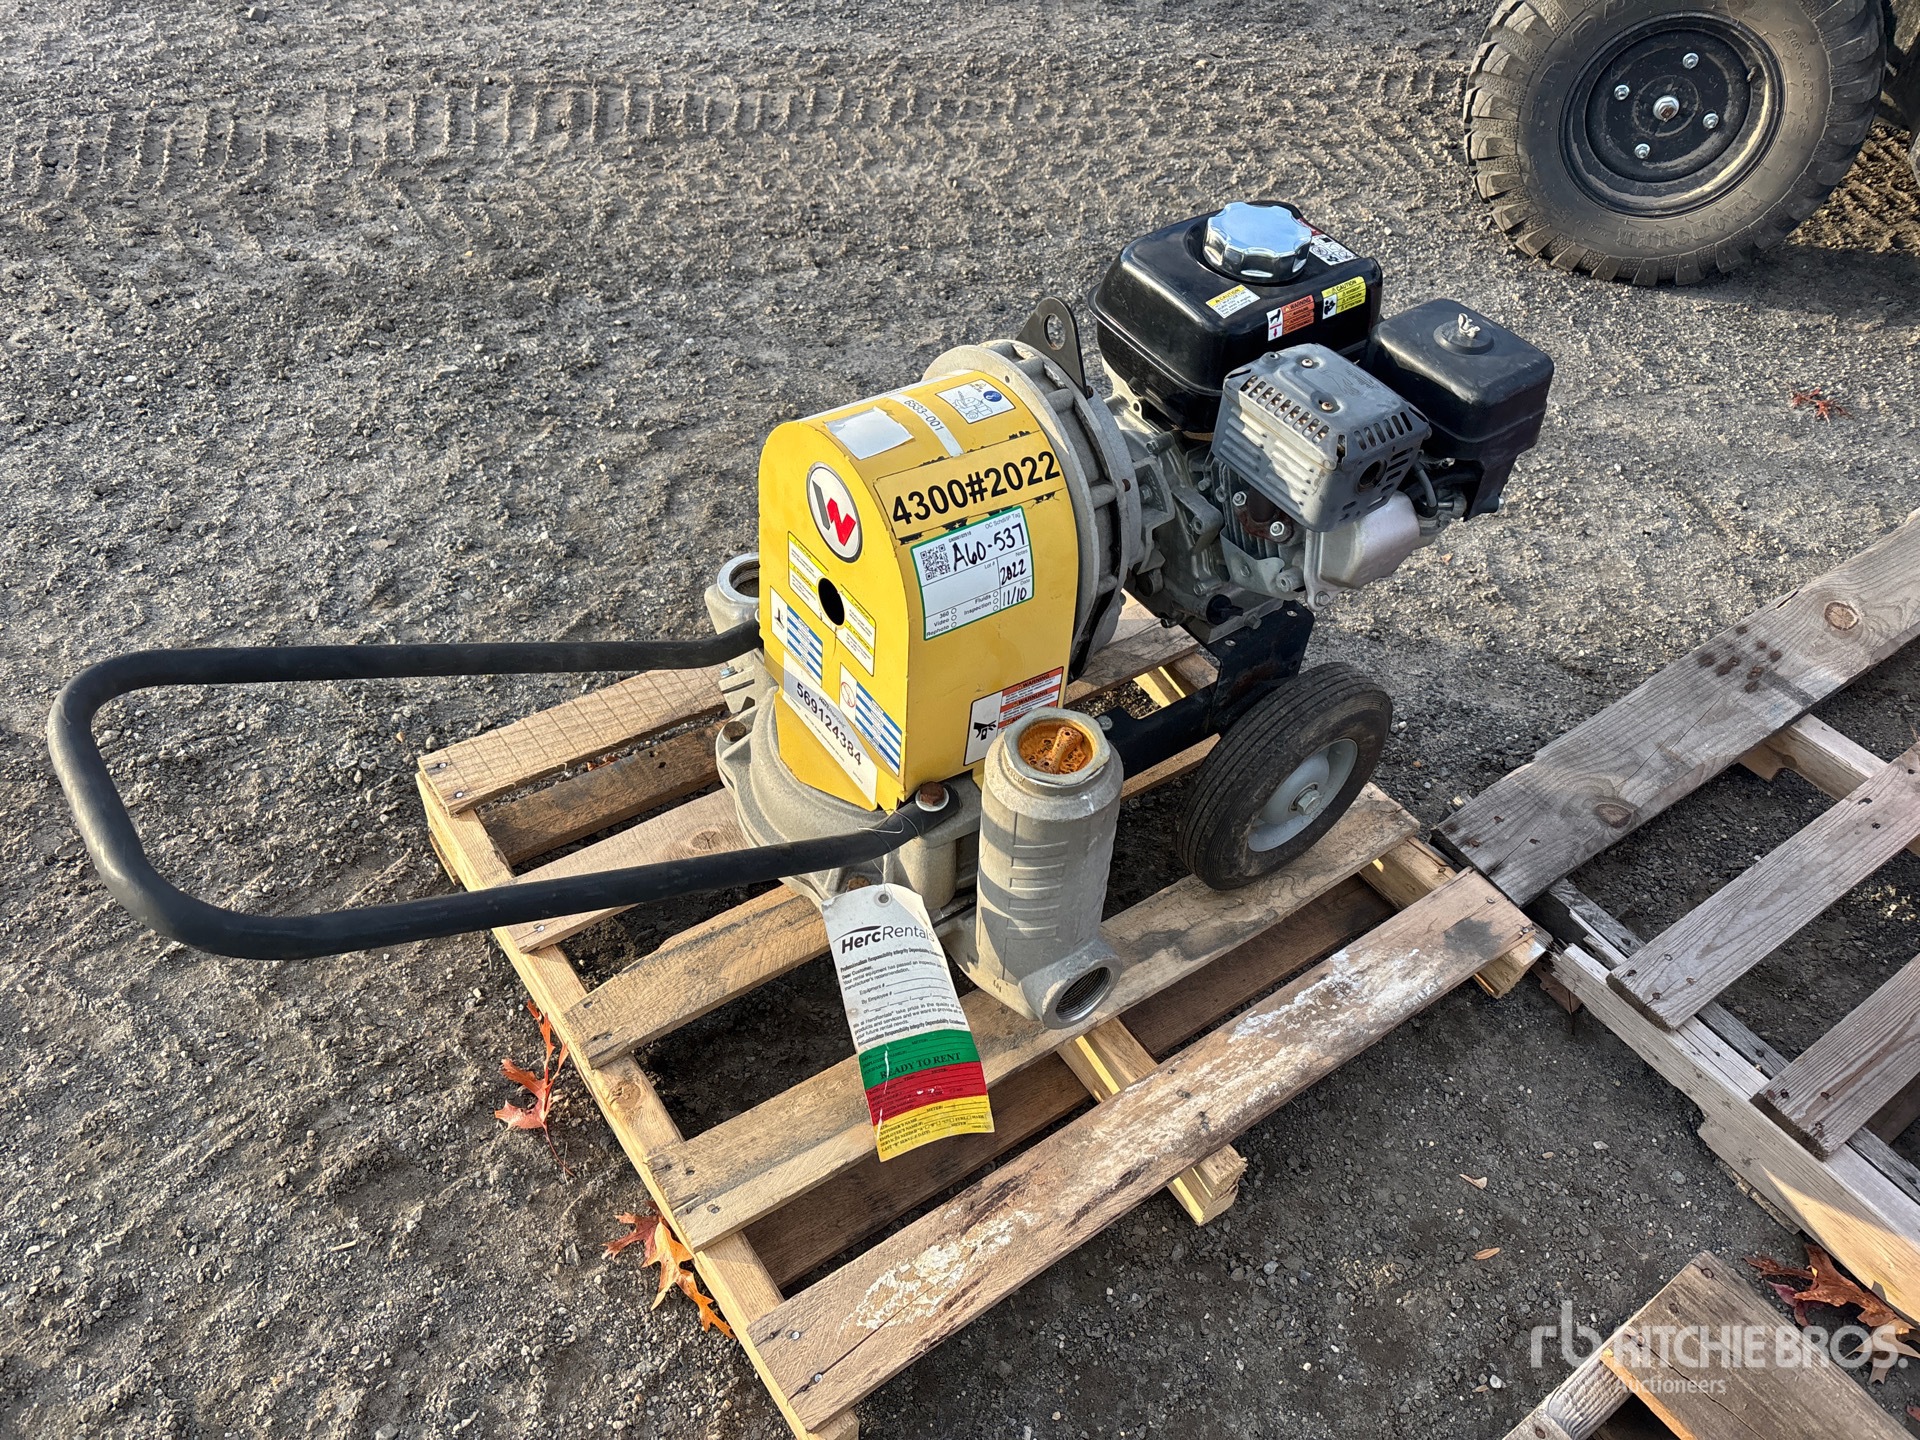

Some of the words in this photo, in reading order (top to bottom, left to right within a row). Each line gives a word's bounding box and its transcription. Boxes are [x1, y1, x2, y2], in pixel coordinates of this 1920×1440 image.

[1335, 279, 1357, 291] CAUTION
[1289, 296, 1311, 309] WARNING
[892, 450, 1060, 524] 4300#2022
[1011, 511, 1020, 519] Tag
[953, 522, 1025, 571] A60-537
[1015, 548, 1028, 556] Notes
[999, 558, 1027, 585] 2022
[1019, 577, 1030, 585] Date
[974, 593, 991, 604] Fluids
[1003, 586, 1027, 606] 11/10
[939, 610, 949, 618] 360
[962, 600, 991, 615] Inspection
[933, 617, 949, 627] Video
[925, 624, 950, 637] Rephoto
[1022, 673, 1049, 687] WARNING
[794, 681, 861, 765] 569124384
[841, 926, 935, 955] HercRentals
[858, 984, 881, 995] Equipment
[867, 992, 888, 1002] Employee
[882, 1015, 902, 1024] services
[915, 1056, 931, 1067] TO
[932, 1051, 961, 1064] RENT
